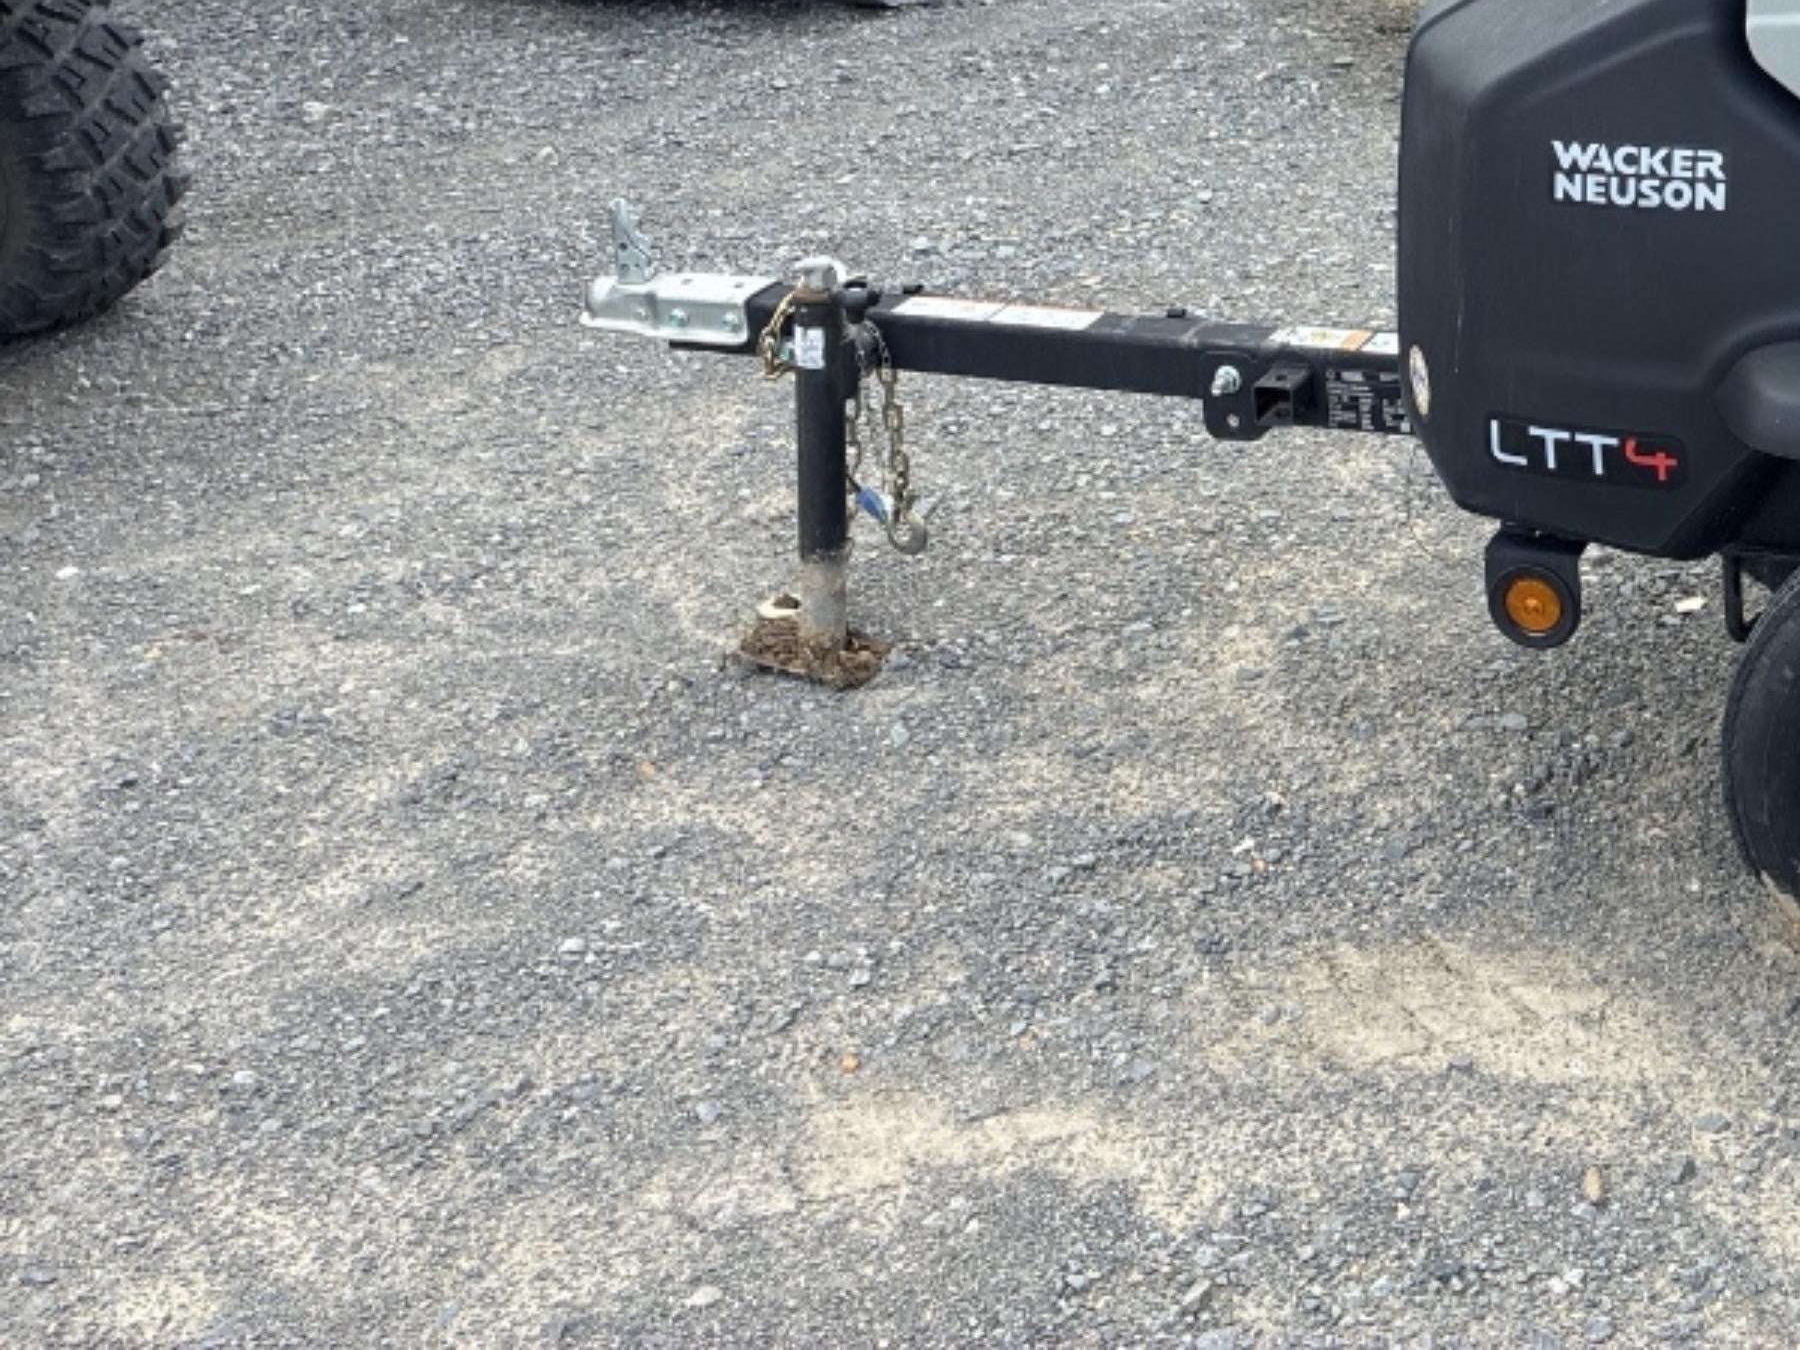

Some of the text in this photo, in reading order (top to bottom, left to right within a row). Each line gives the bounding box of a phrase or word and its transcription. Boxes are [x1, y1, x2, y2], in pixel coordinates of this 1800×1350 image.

[1551, 140, 1727, 180] WACKER
[1552, 172, 1727, 212] NEUSON
[1489, 418, 1678, 482] LTT4
